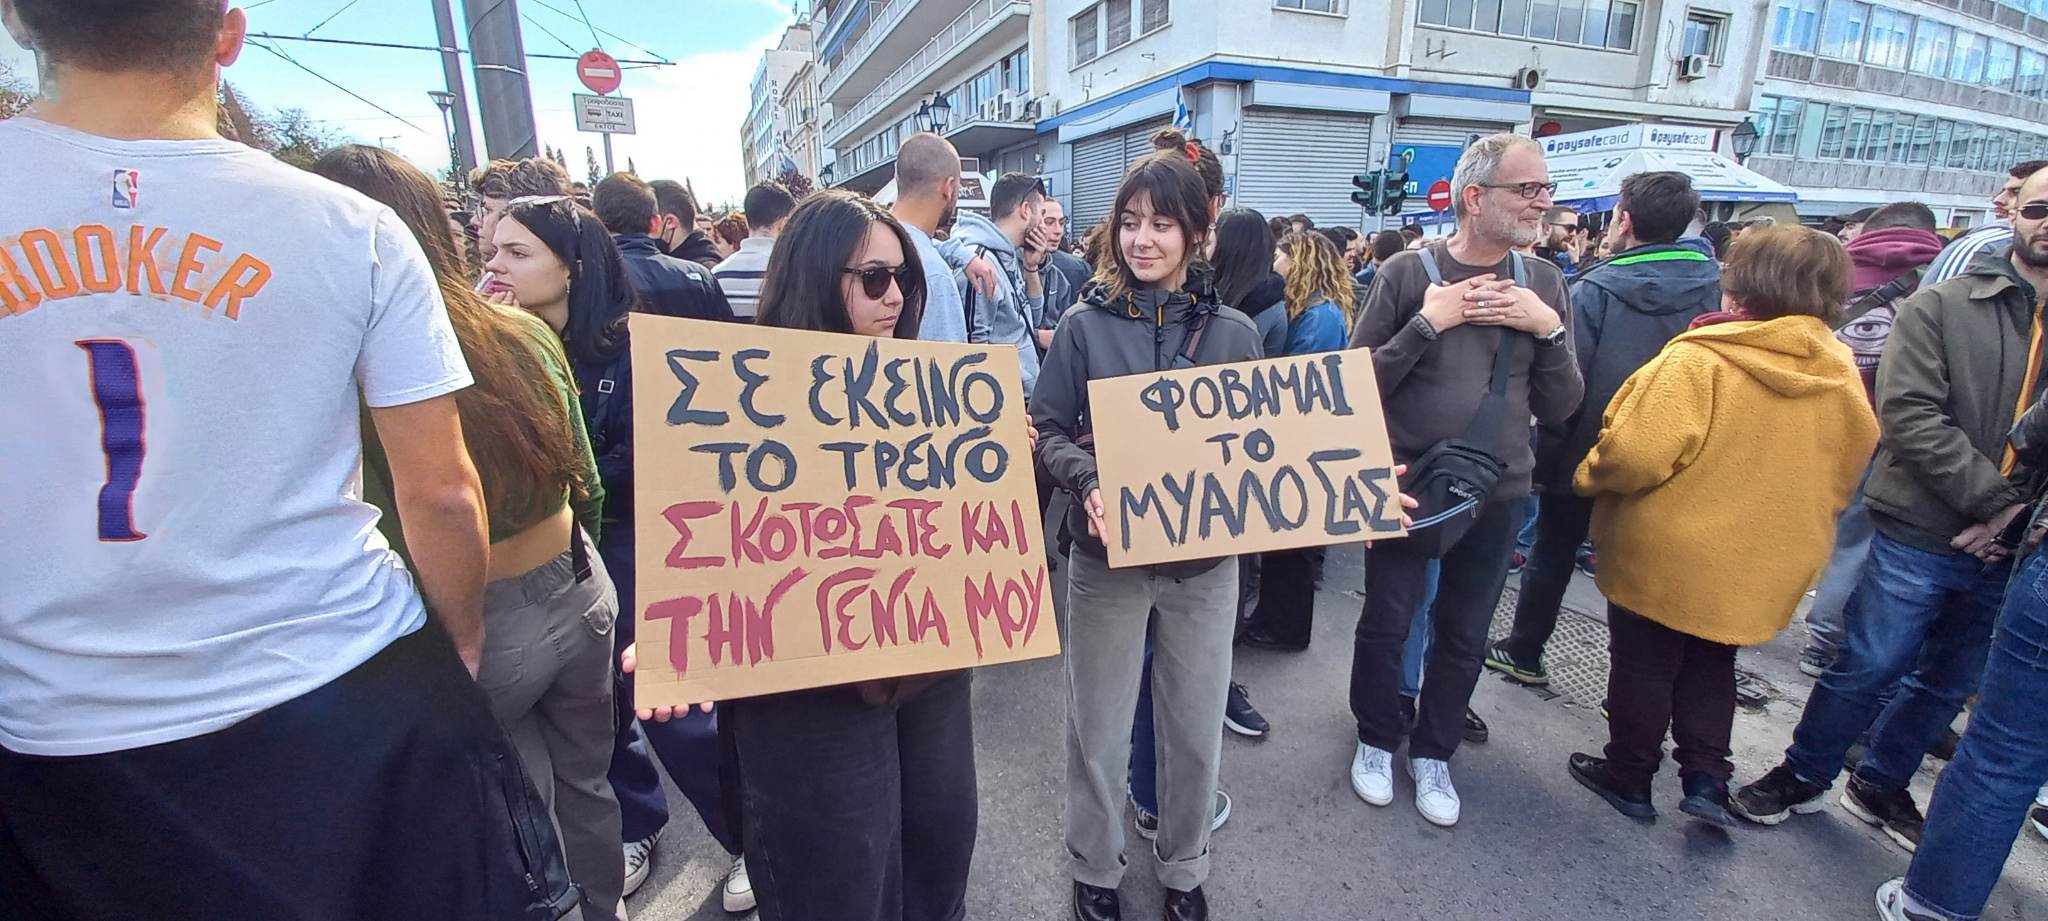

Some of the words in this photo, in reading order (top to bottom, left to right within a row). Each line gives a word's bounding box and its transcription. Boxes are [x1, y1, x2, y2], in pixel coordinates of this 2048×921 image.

[1557, 131, 1630, 153] paysafecard
[1657, 132, 1707, 146] paysafecard
[665, 348, 786, 428] ΣΕ
[808, 340, 1004, 429] ΕΚΕΙΝΟ
[1140, 354, 1354, 432] ΦΟΒΑΜΑΙ
[74, 338, 147, 542] 1
[688, 438, 797, 494] ΤΟ
[818, 426, 1008, 492] ΤΡΕΝΟ
[1204, 428, 1275, 465] ΤΟ
[1120, 464, 1308, 553] ΜΥΑΛΟ
[1306, 448, 1402, 536] ΣΑΣ
[1449, 485, 1473, 499] SPORT
[660, 496, 952, 569] ΣΚΟΤΩΣΑΤΕ
[961, 500, 1029, 557] ΚΑΙ
[644, 566, 812, 681] ΤΗΝ
[815, 566, 950, 655] ΓΕΝΙΑ
[964, 564, 1045, 662] ΜΟΥ
